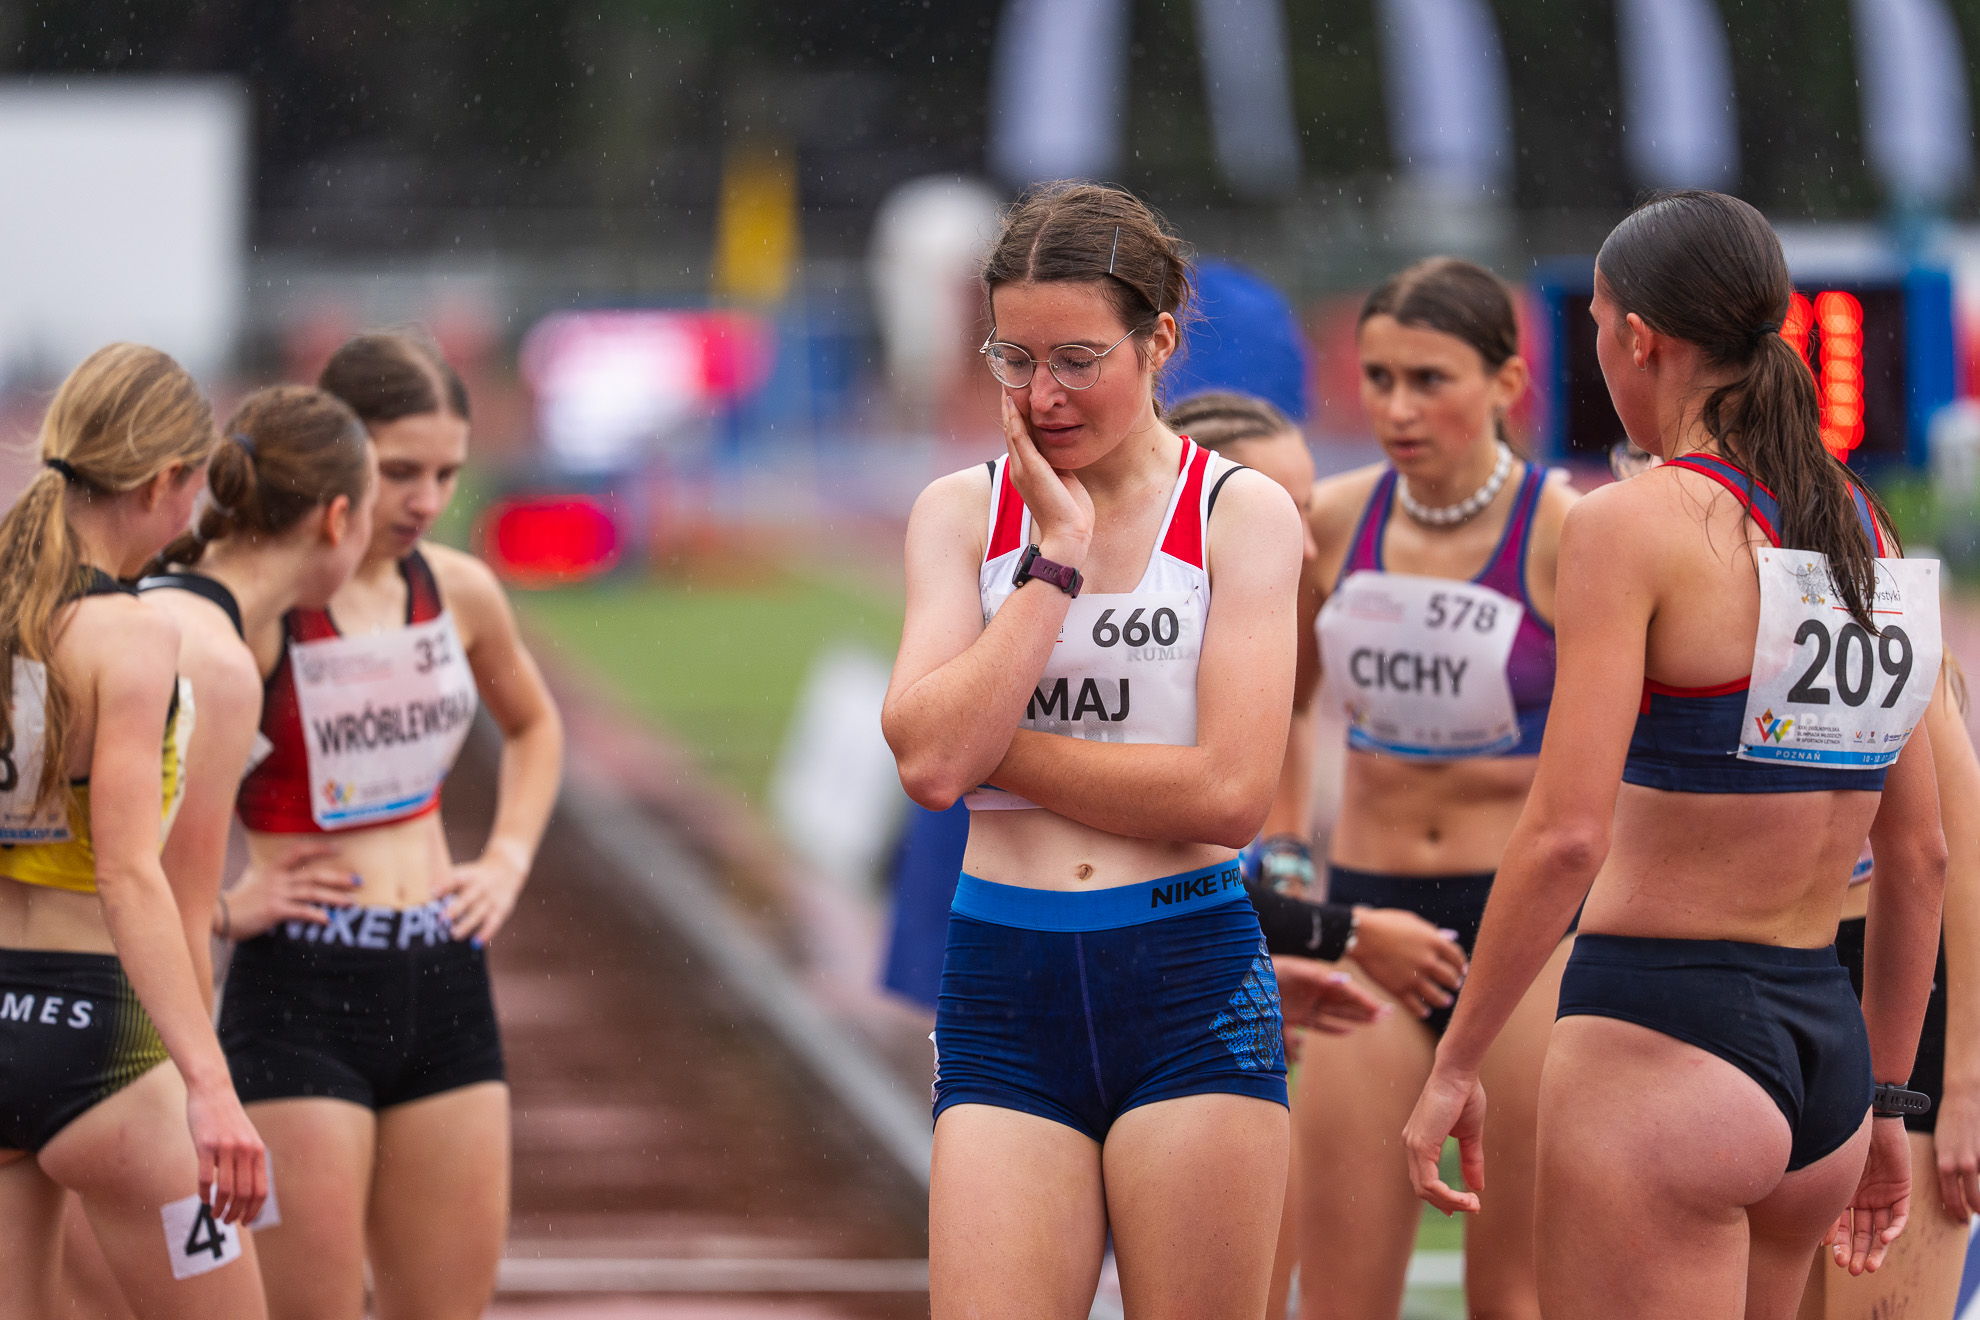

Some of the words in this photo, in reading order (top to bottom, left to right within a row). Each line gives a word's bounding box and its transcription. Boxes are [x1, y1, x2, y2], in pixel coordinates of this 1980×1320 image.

[1092, 607, 1180, 648] 660
[1426, 594, 1498, 633] 578
[1349, 647, 1468, 697] CICHY
[1787, 619, 1913, 709] 209
[1027, 678, 1130, 722] MAJ
[1776, 750, 1821, 760] POZNAŃ
[1151, 874, 1218, 909] NIKE
[396, 896, 453, 949] PR
[184, 1200, 227, 1260] 4
